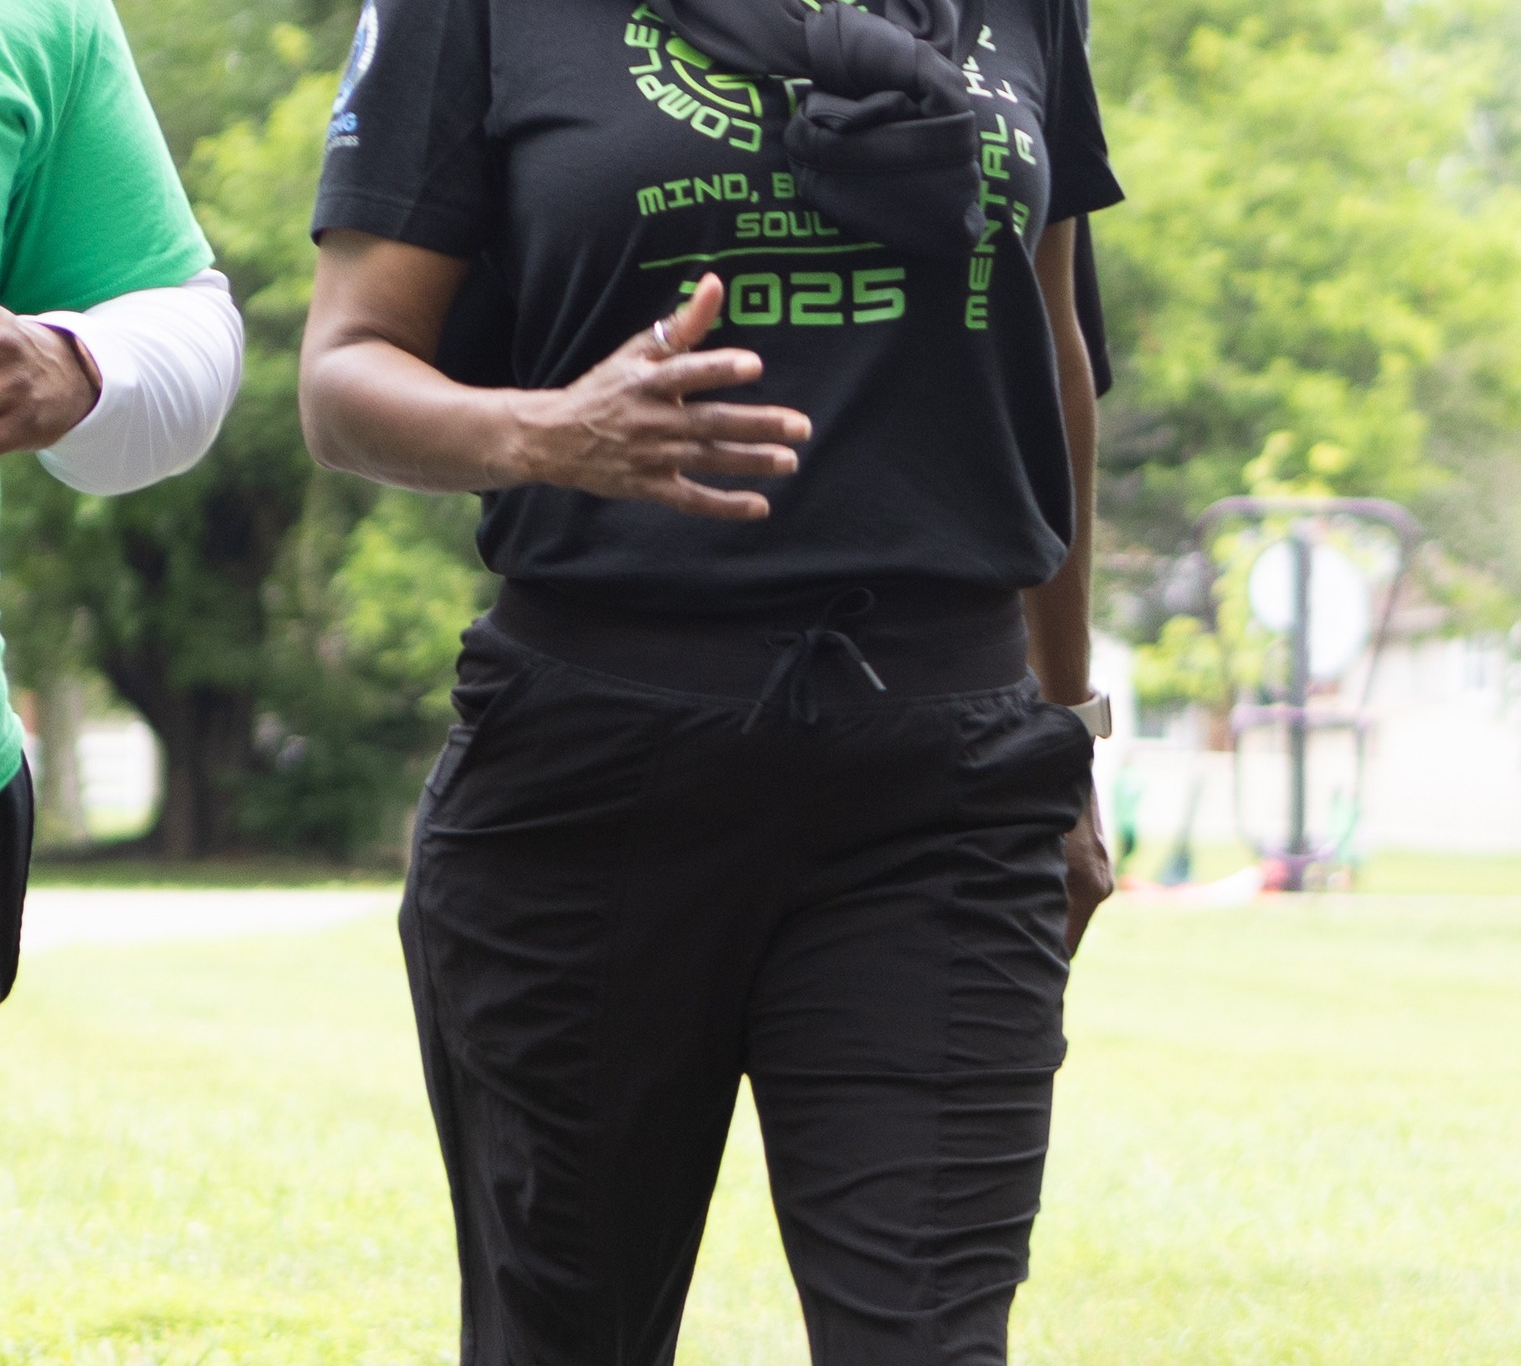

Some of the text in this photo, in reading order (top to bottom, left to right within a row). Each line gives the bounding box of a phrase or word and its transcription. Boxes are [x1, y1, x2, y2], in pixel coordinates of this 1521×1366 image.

[636, 172, 761, 217] MIND,
[735, 210, 841, 239] SOUL
[677, 267, 907, 330] 025
